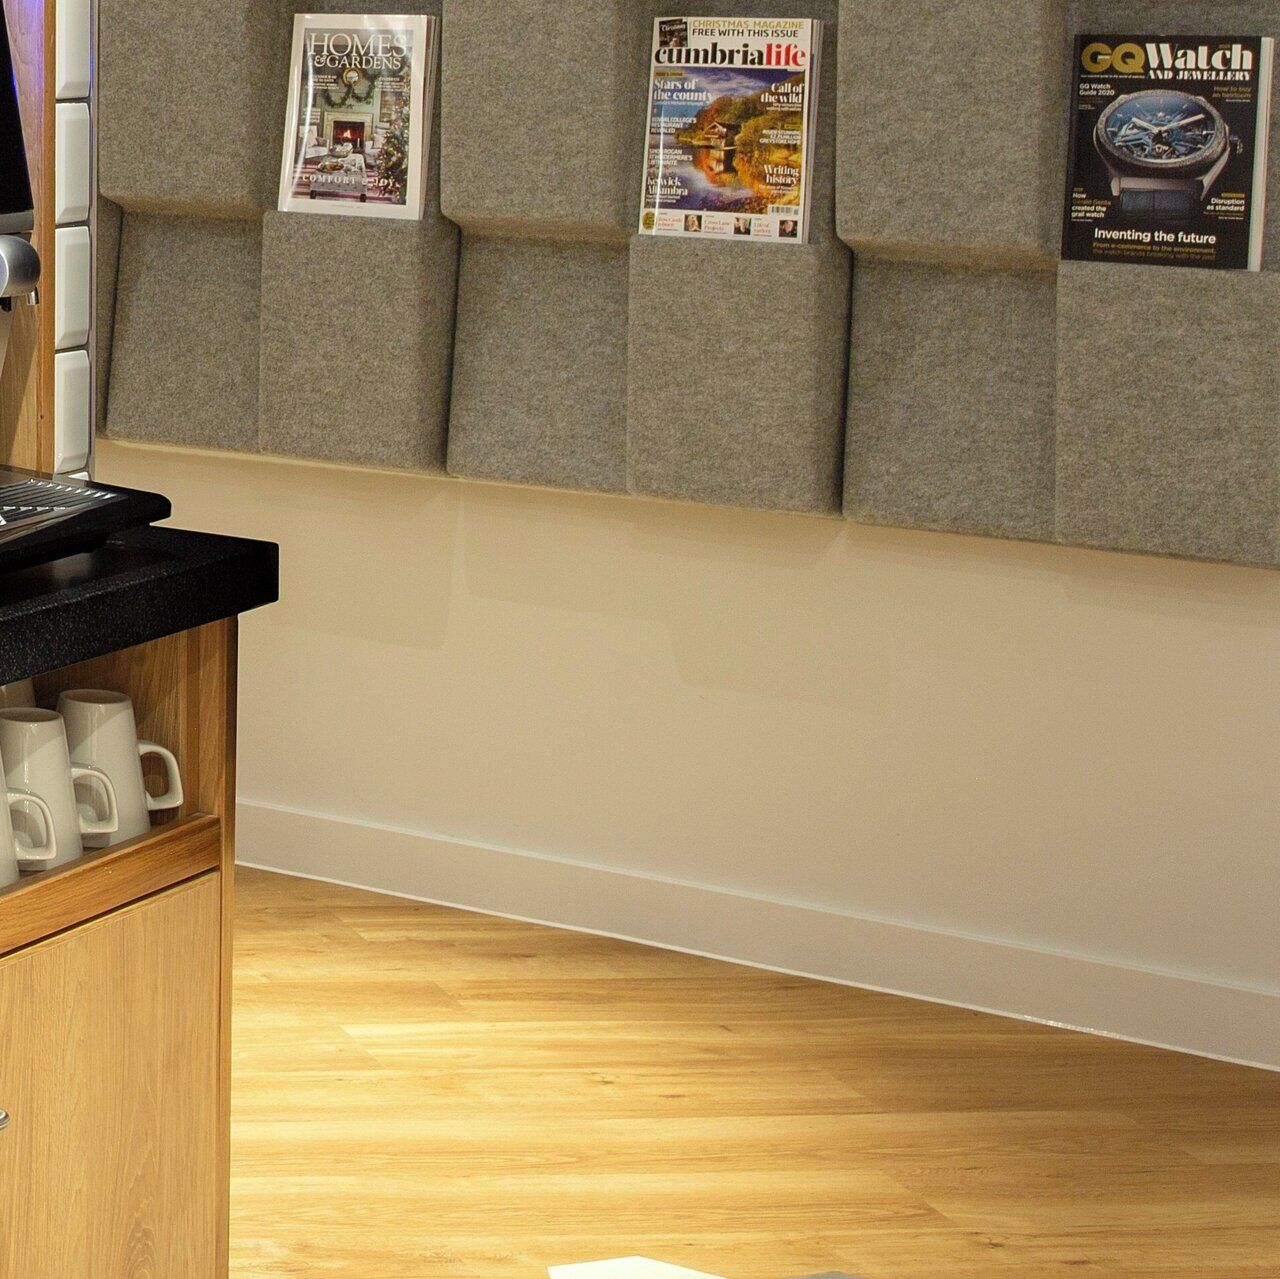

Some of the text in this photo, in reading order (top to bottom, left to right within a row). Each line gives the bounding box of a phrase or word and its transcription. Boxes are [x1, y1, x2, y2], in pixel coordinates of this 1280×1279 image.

[692, 20, 804, 29] CHRISTMAS MAGAZINE
[692, 28, 715, 36] FREE
[718, 29, 744, 37] WITH
[771, 30, 799, 38] ISSUE
[309, 33, 407, 57] HOMES
[654, 42, 806, 67] cumbrialife
[1081, 42, 1253, 73] GQ Watch
[1147, 69, 1253, 81] AND JEWELLERY
[653, 79, 698, 90] Stars of
[771, 83, 804, 93] Call of
[653, 90, 713, 103] the county
[761, 92, 802, 104] the wild
[764, 164, 799, 177] Writing
[302, 175, 355, 184] COMFORT
[647, 177, 681, 186] Kewick
[766, 174, 798, 186] history
[1094, 228, 1217, 244] Inventing the future
